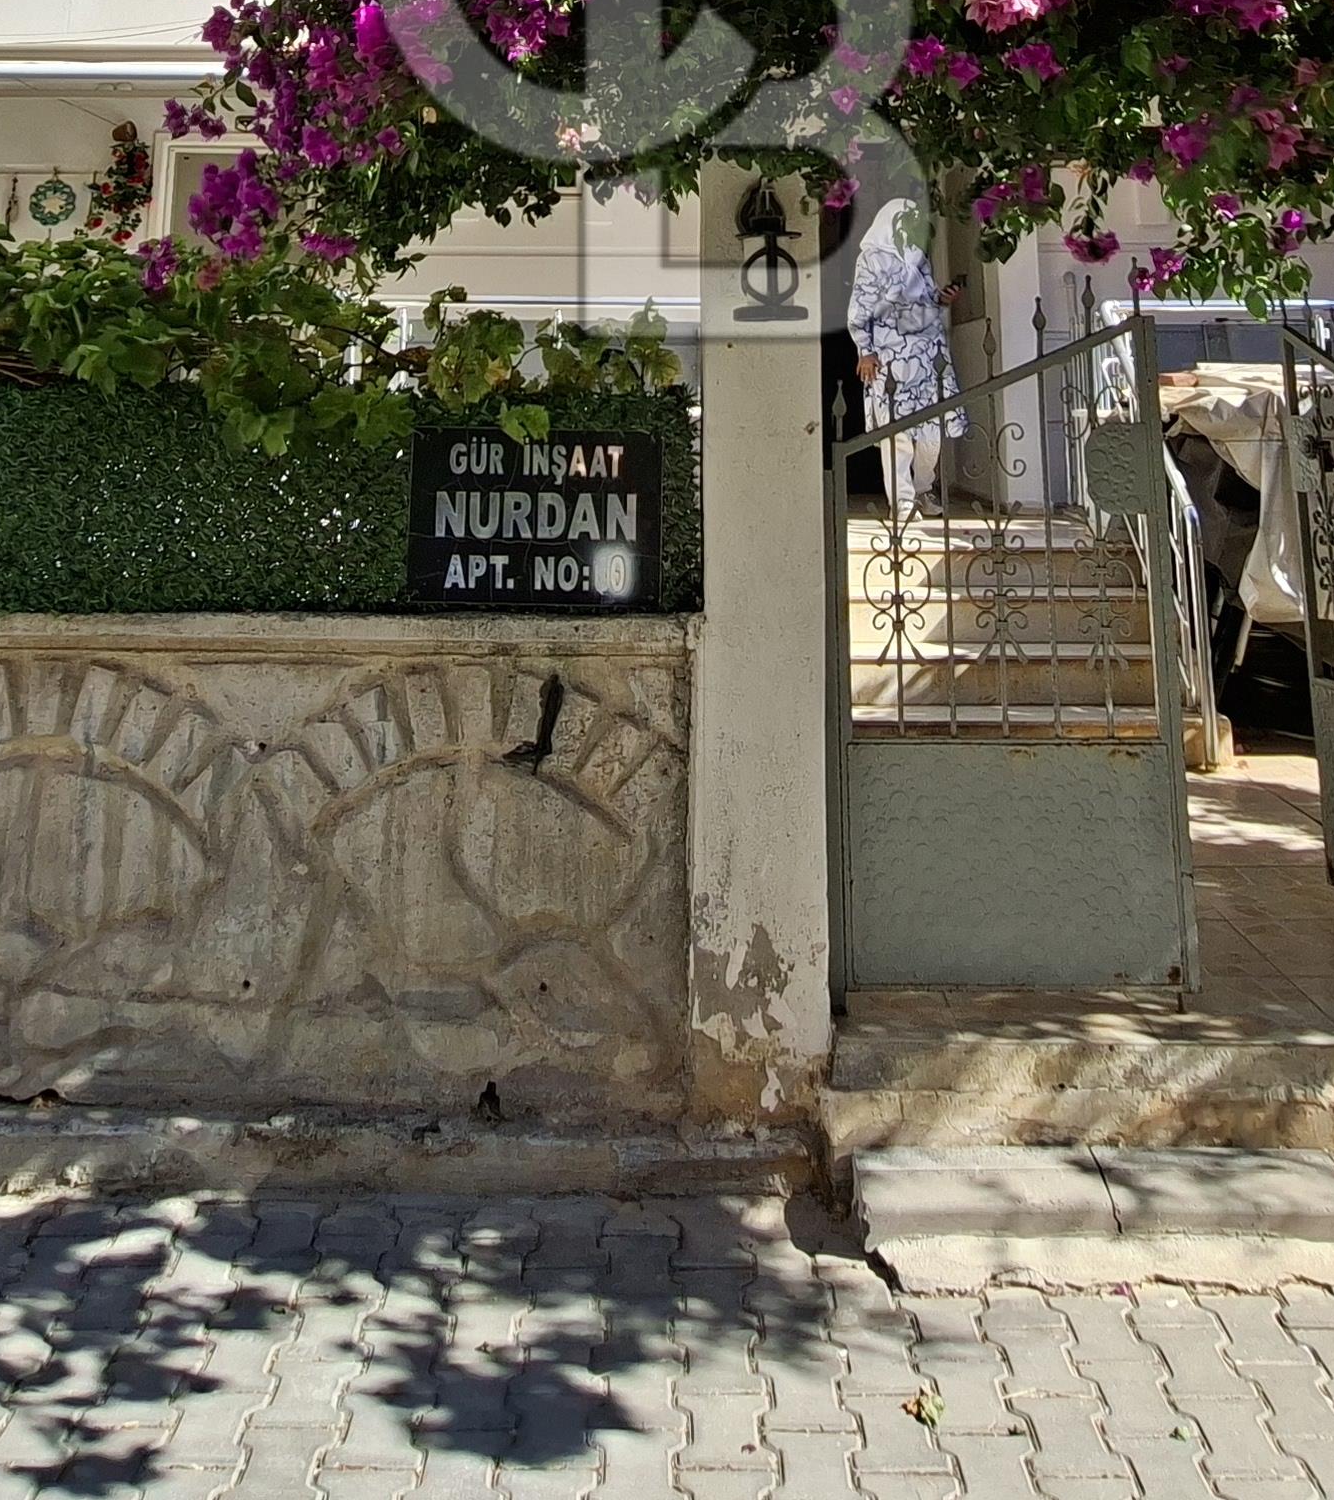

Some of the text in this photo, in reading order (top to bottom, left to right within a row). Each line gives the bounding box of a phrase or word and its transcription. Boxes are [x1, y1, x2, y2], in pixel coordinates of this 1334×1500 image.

[449, 436, 624, 485] GÜR İNŞAAT
[434, 490, 638, 543] NURDAN
[443, 554, 515, 590] APT.
